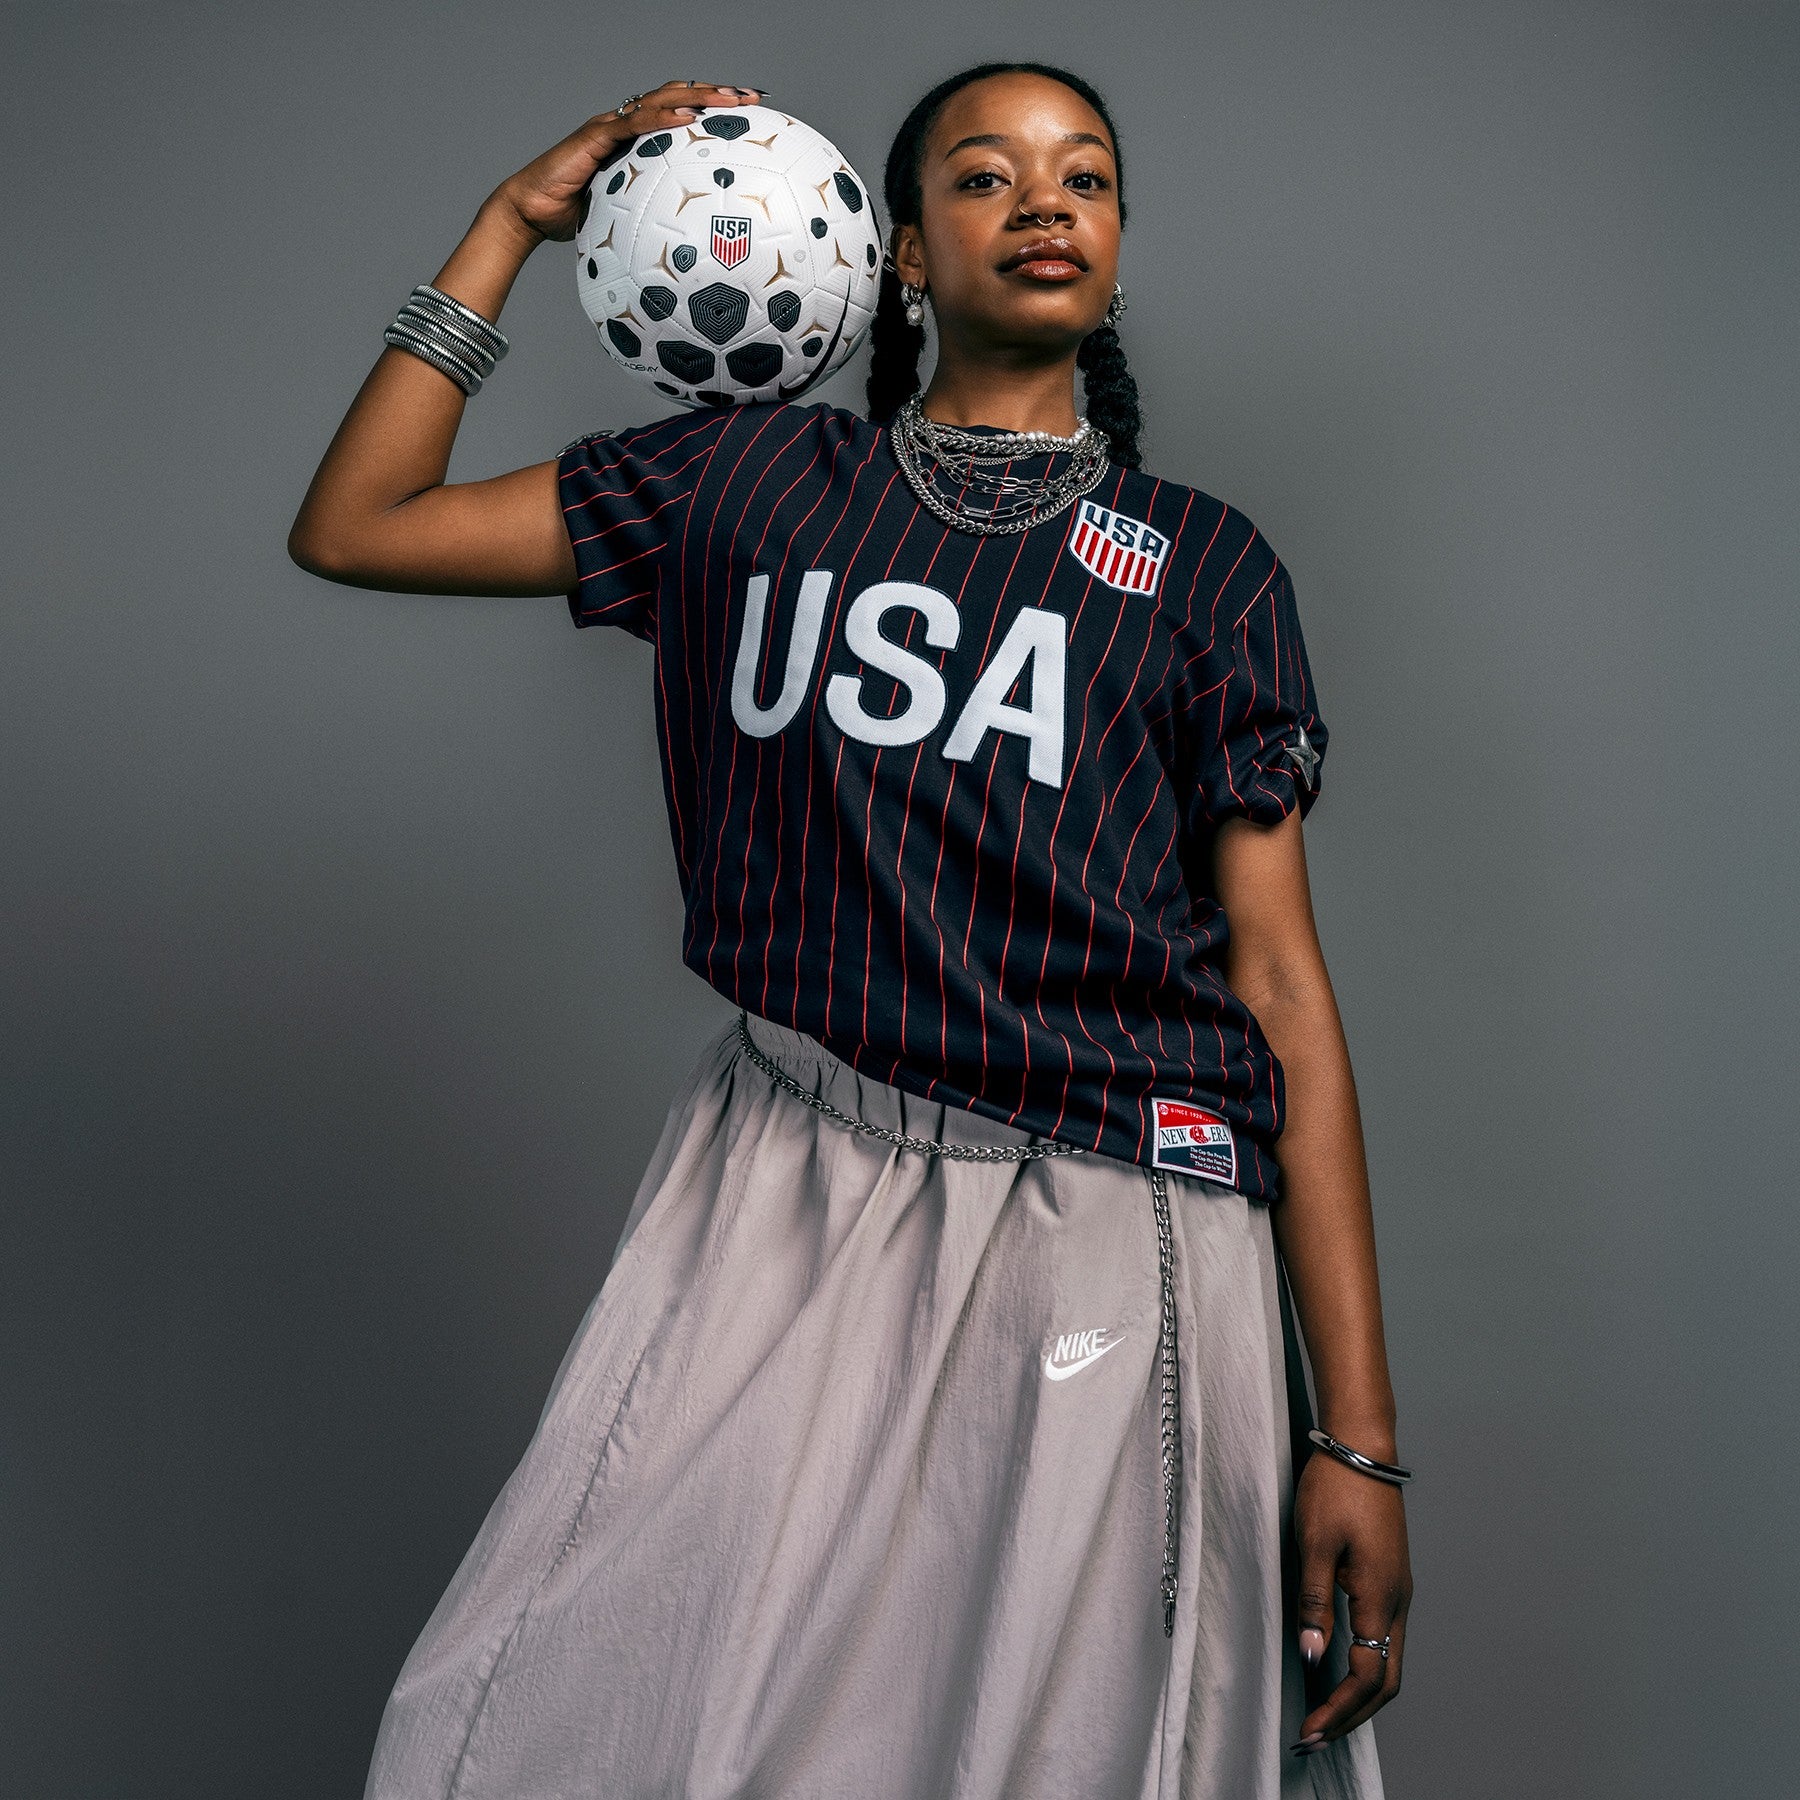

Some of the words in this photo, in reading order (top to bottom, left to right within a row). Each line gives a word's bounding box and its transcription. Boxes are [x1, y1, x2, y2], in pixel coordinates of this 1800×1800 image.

[715, 219, 748, 240] USA
[1084, 504, 1164, 559] USA
[730, 568, 1068, 790] USA
[1170, 1108, 1188, 1116] SINCE
[1160, 1127, 1187, 1146] NEW
[1210, 1126, 1229, 1142] ERA
[1053, 1327, 1107, 1363] NIKE
